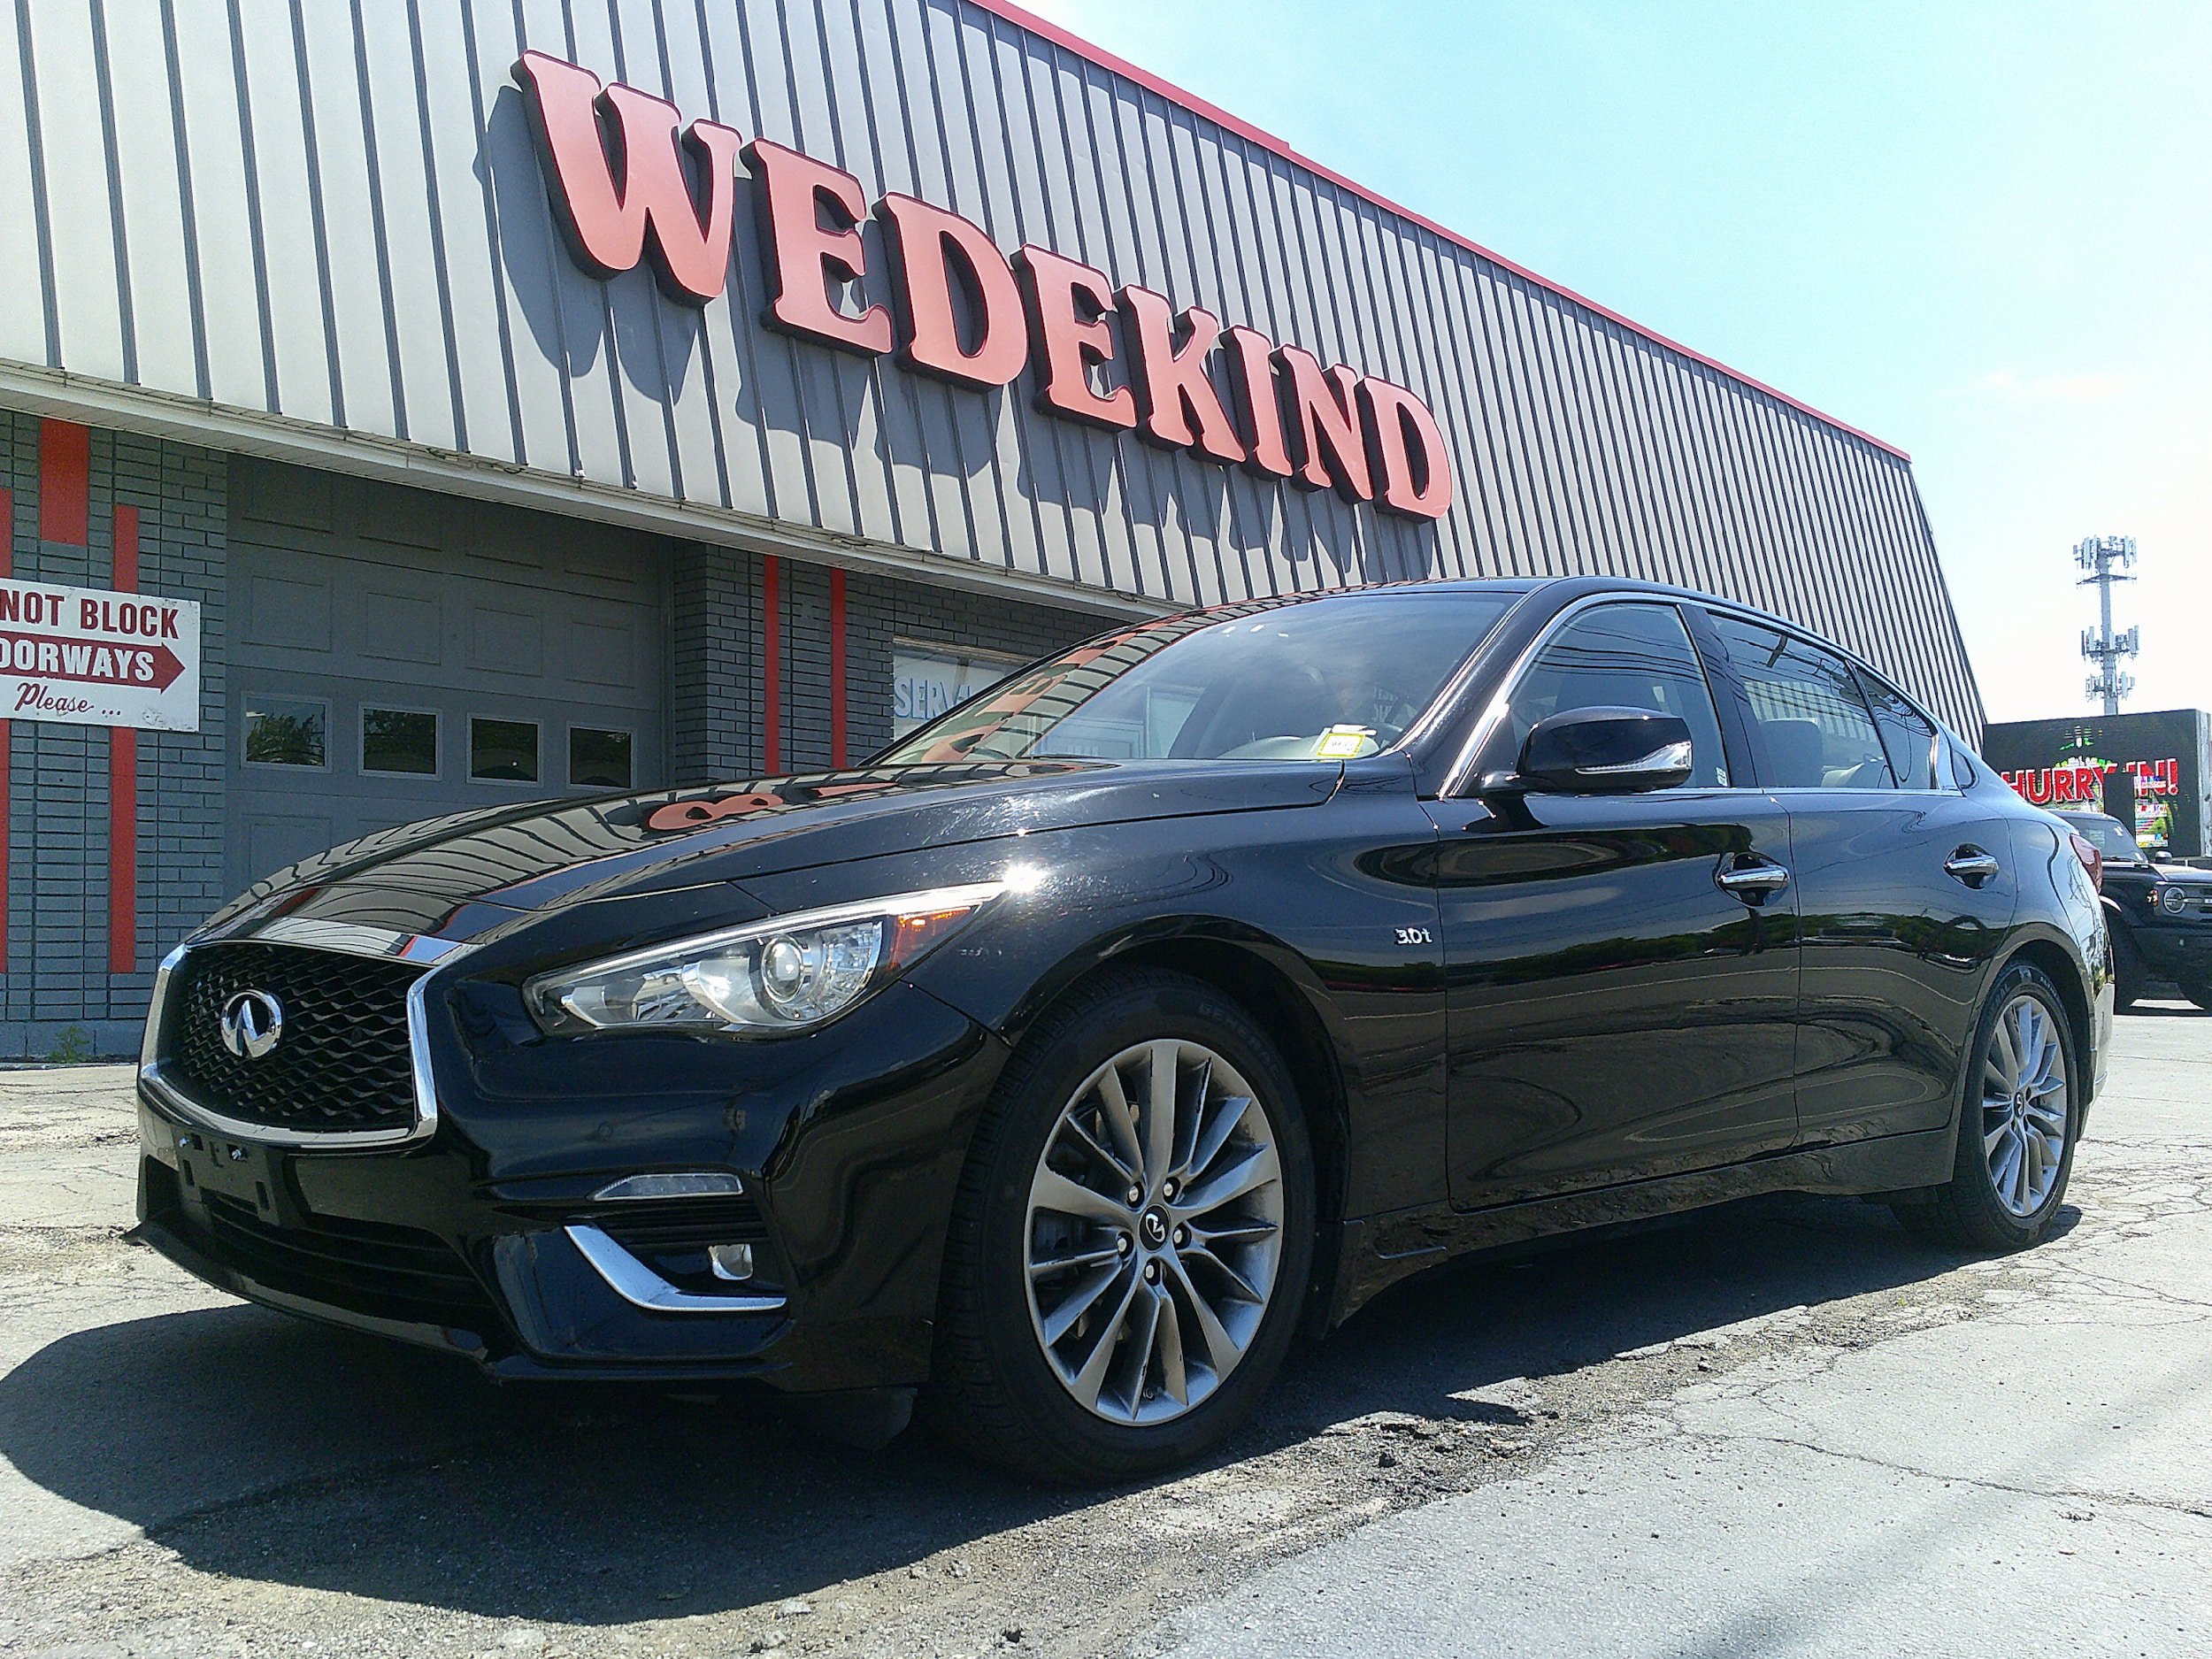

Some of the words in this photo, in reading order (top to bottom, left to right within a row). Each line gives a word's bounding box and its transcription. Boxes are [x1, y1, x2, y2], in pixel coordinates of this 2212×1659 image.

[511, 50, 1454, 524] WEDEKIND
[0, 588, 65, 626] NOT
[80, 598, 180, 640] BLOCK
